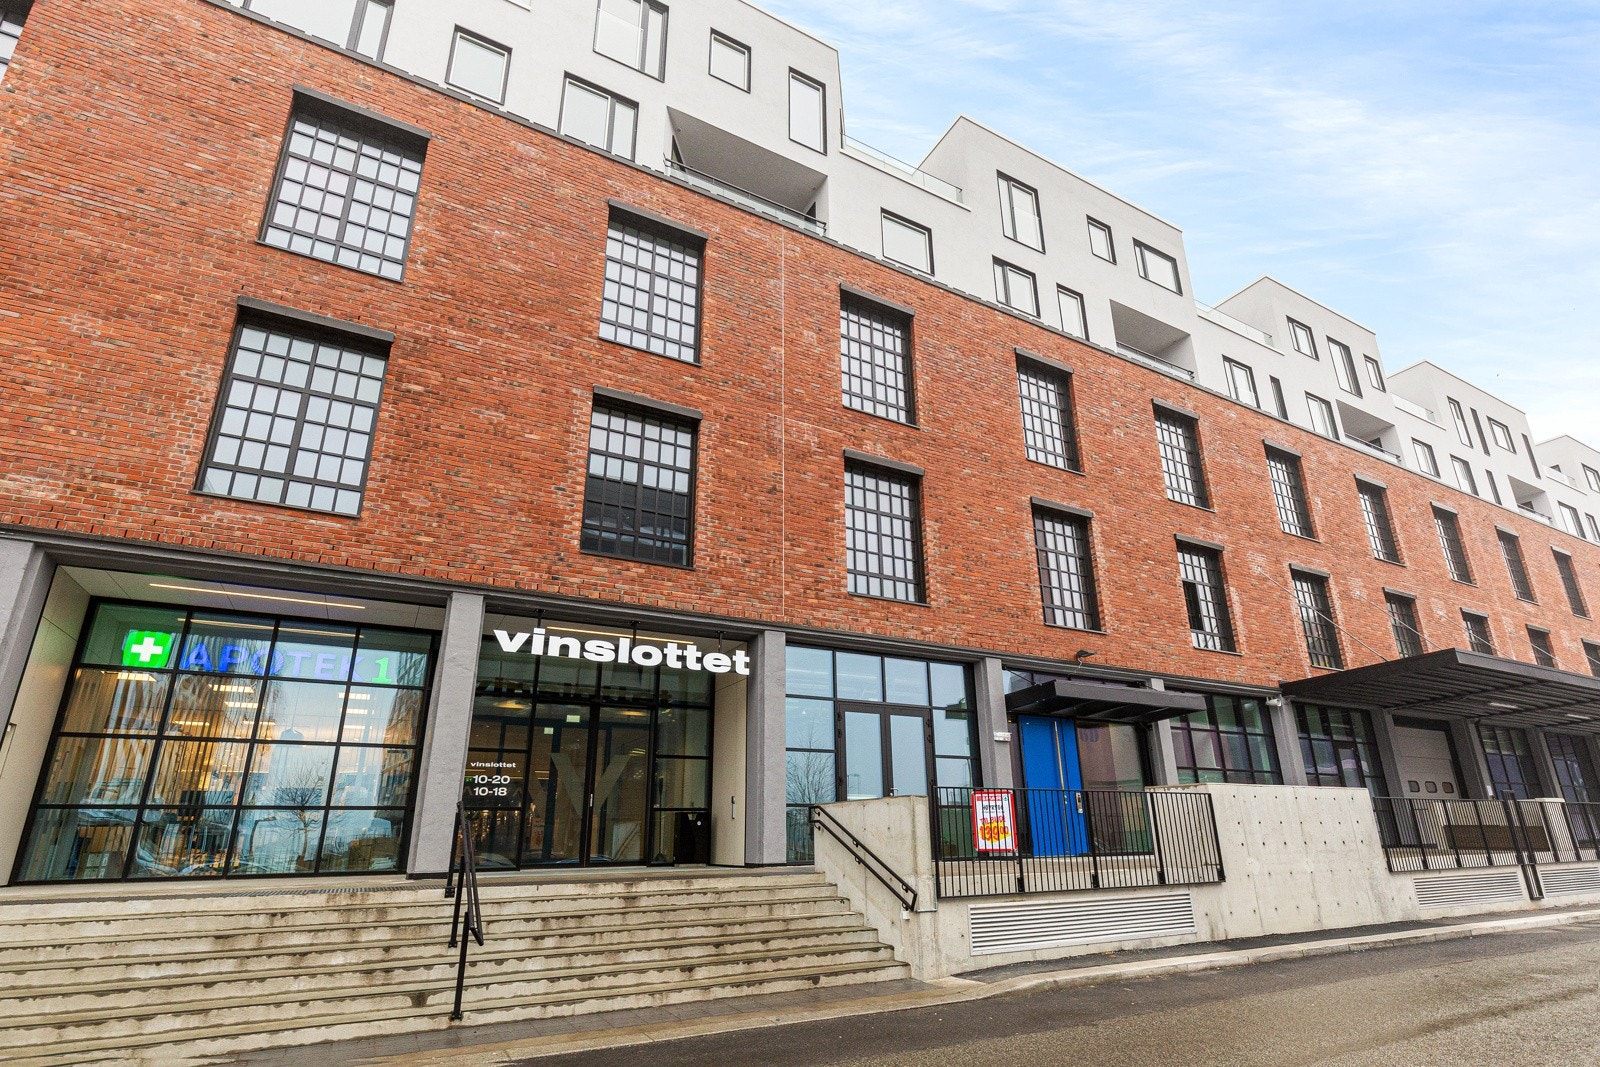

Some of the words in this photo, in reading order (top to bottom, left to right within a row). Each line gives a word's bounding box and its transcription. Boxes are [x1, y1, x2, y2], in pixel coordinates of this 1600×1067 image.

[182, 642, 367, 681] APOTEK
[371, 657, 392, 684] 1
[493, 627, 750, 676] vinslottet
[473, 775, 510, 784] 10-20
[473, 787, 507, 796] 10-18
